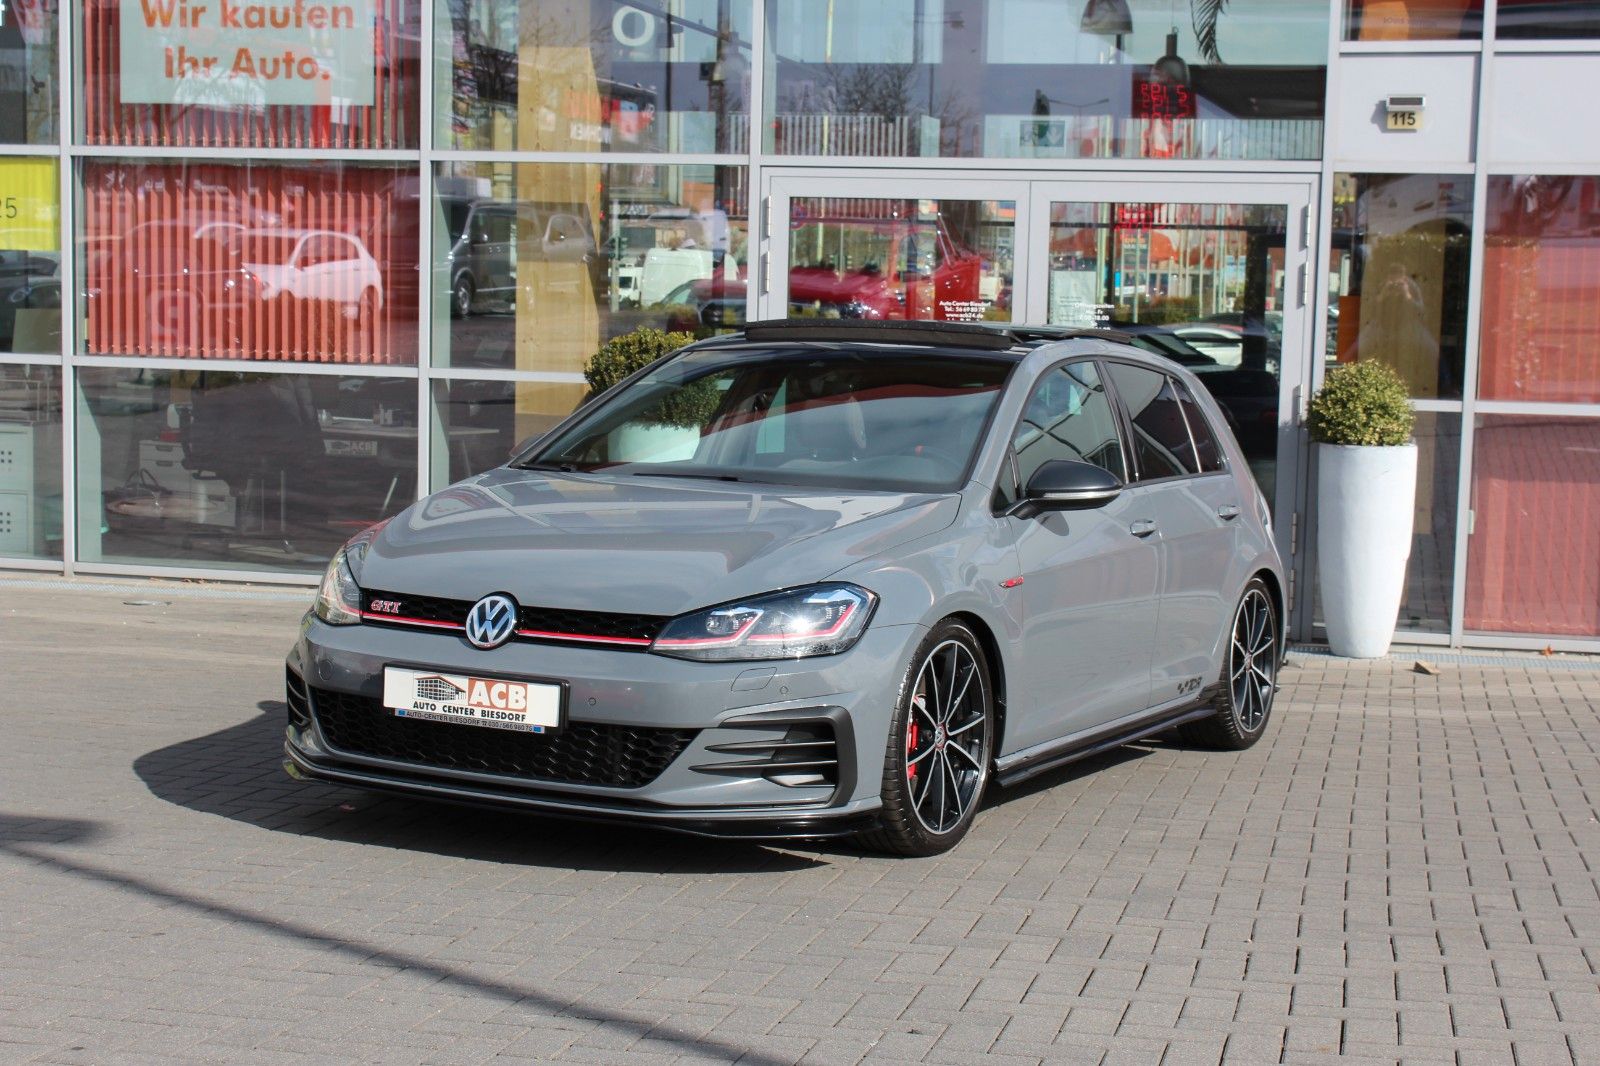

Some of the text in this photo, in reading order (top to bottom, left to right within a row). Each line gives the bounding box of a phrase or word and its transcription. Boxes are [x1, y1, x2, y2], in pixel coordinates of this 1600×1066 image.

[139, 0, 354, 29] Wir kaufen
[164, 46, 330, 81] Ihr Auto.
[1392, 112, 1416, 126] 115
[0, 197, 17, 219] 5
[370, 599, 402, 614] GTI
[469, 680, 527, 711] ACB
[406, 710, 448, 722] AUTO-CENTER
[449, 717, 481, 726] BIESDORF
[412, 701, 527, 722] AUTO CENTER BIESDORF
